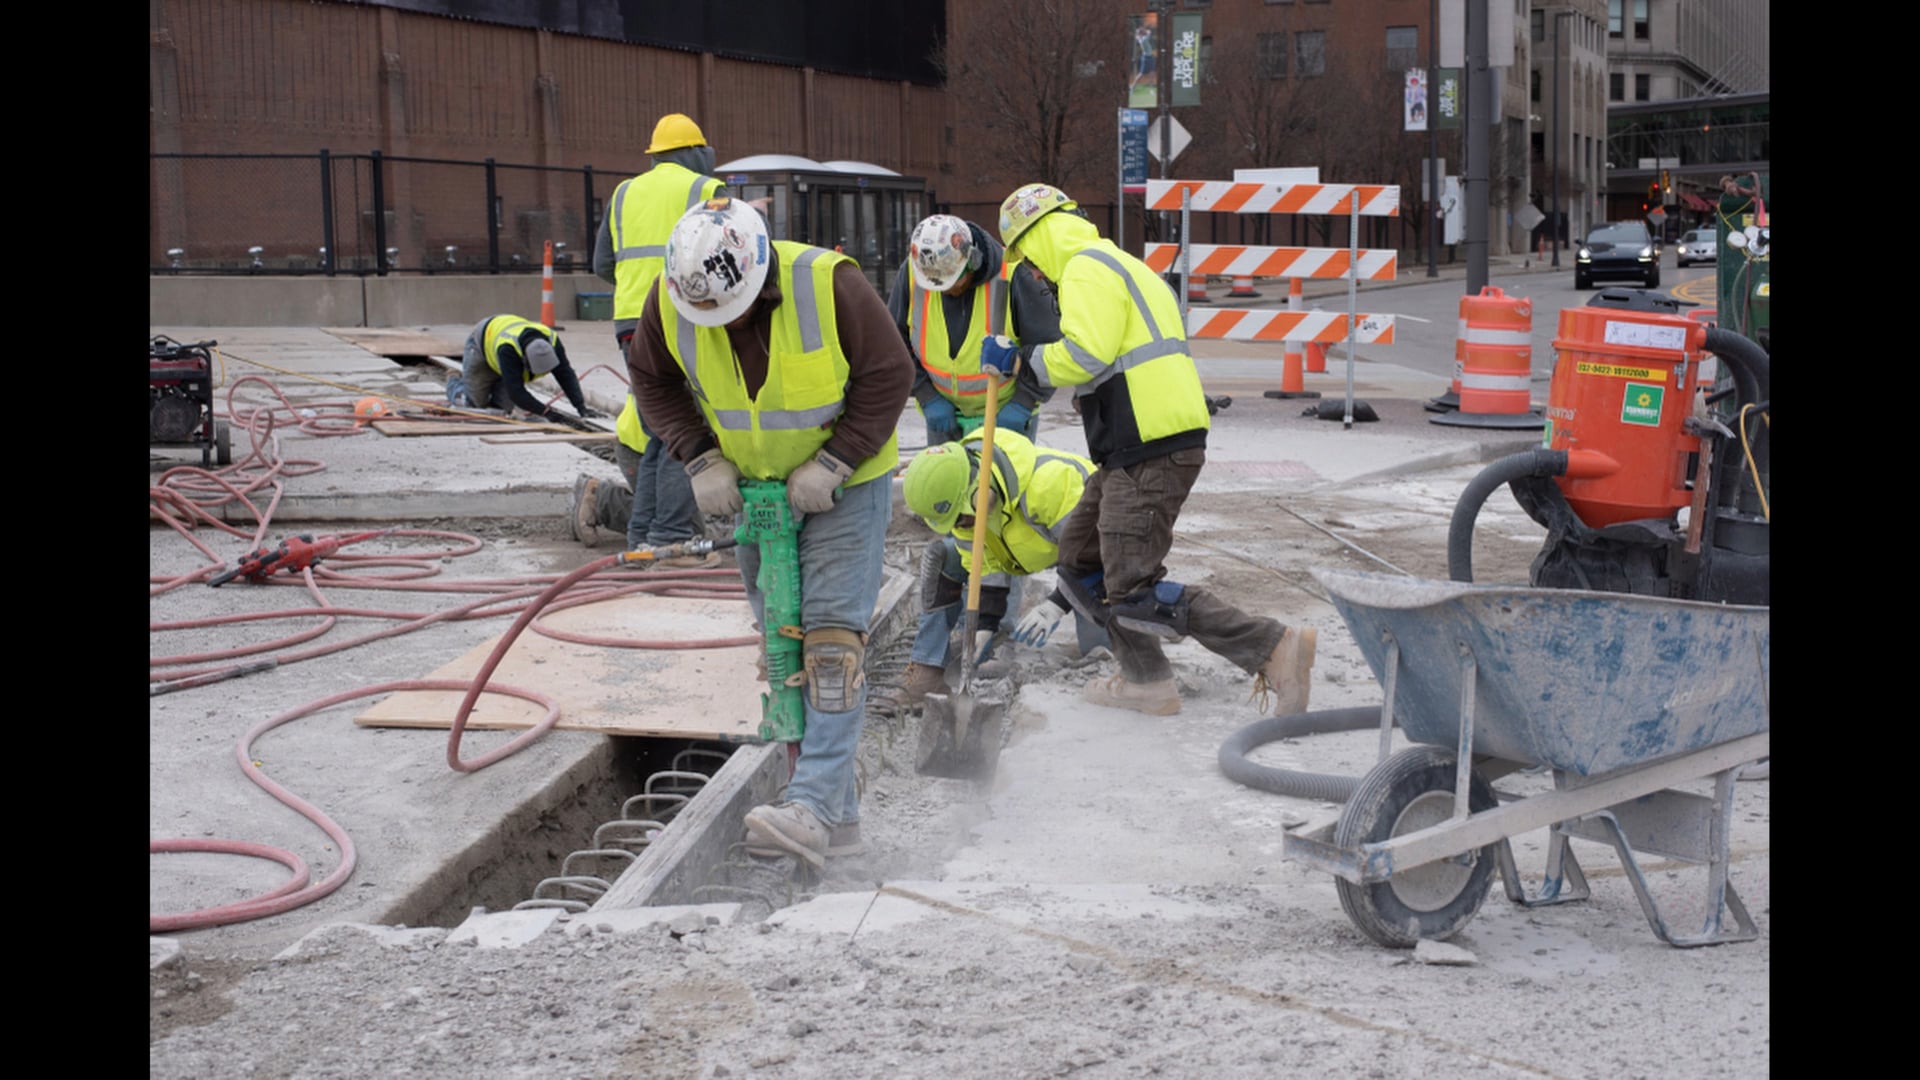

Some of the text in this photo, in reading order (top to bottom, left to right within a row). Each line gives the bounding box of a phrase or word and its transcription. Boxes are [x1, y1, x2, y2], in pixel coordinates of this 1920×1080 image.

[1173, 40, 1183, 81] TIME TO
[1182, 31, 1194, 88] EXPLORE
